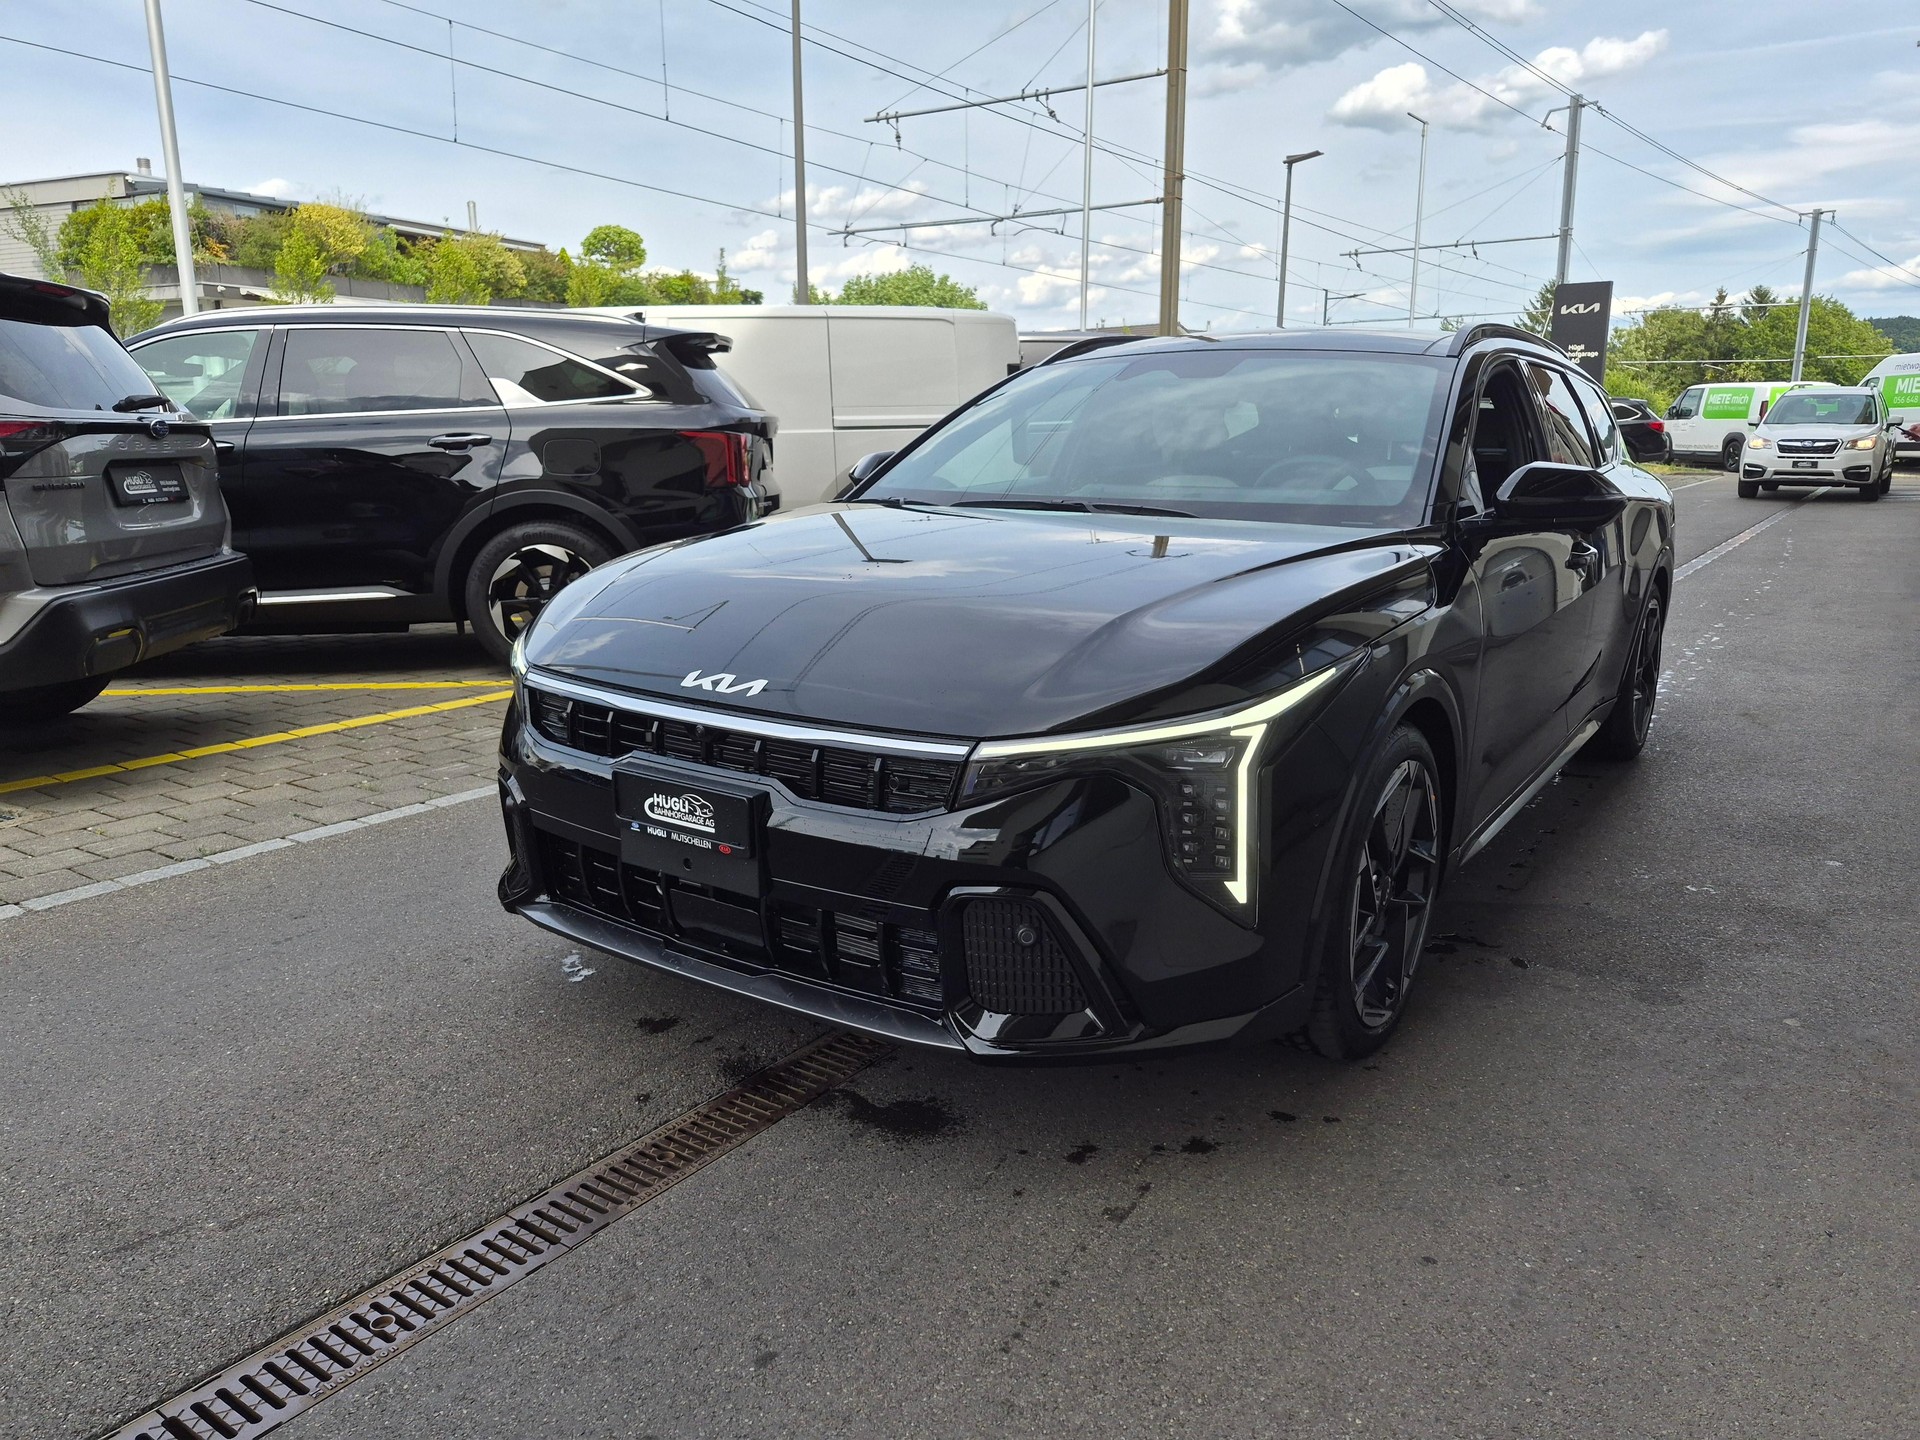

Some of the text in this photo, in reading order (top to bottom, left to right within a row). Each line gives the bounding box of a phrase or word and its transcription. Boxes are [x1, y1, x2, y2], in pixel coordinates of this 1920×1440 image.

[1560, 302, 1600, 314] KIA
[1708, 393, 1749, 405] MIETE mich
[680, 669, 769, 697] KIA
[654, 806, 715, 827] BAHNHOFGARAGE AG
[671, 832, 711, 850] MUTSCHELLEN
